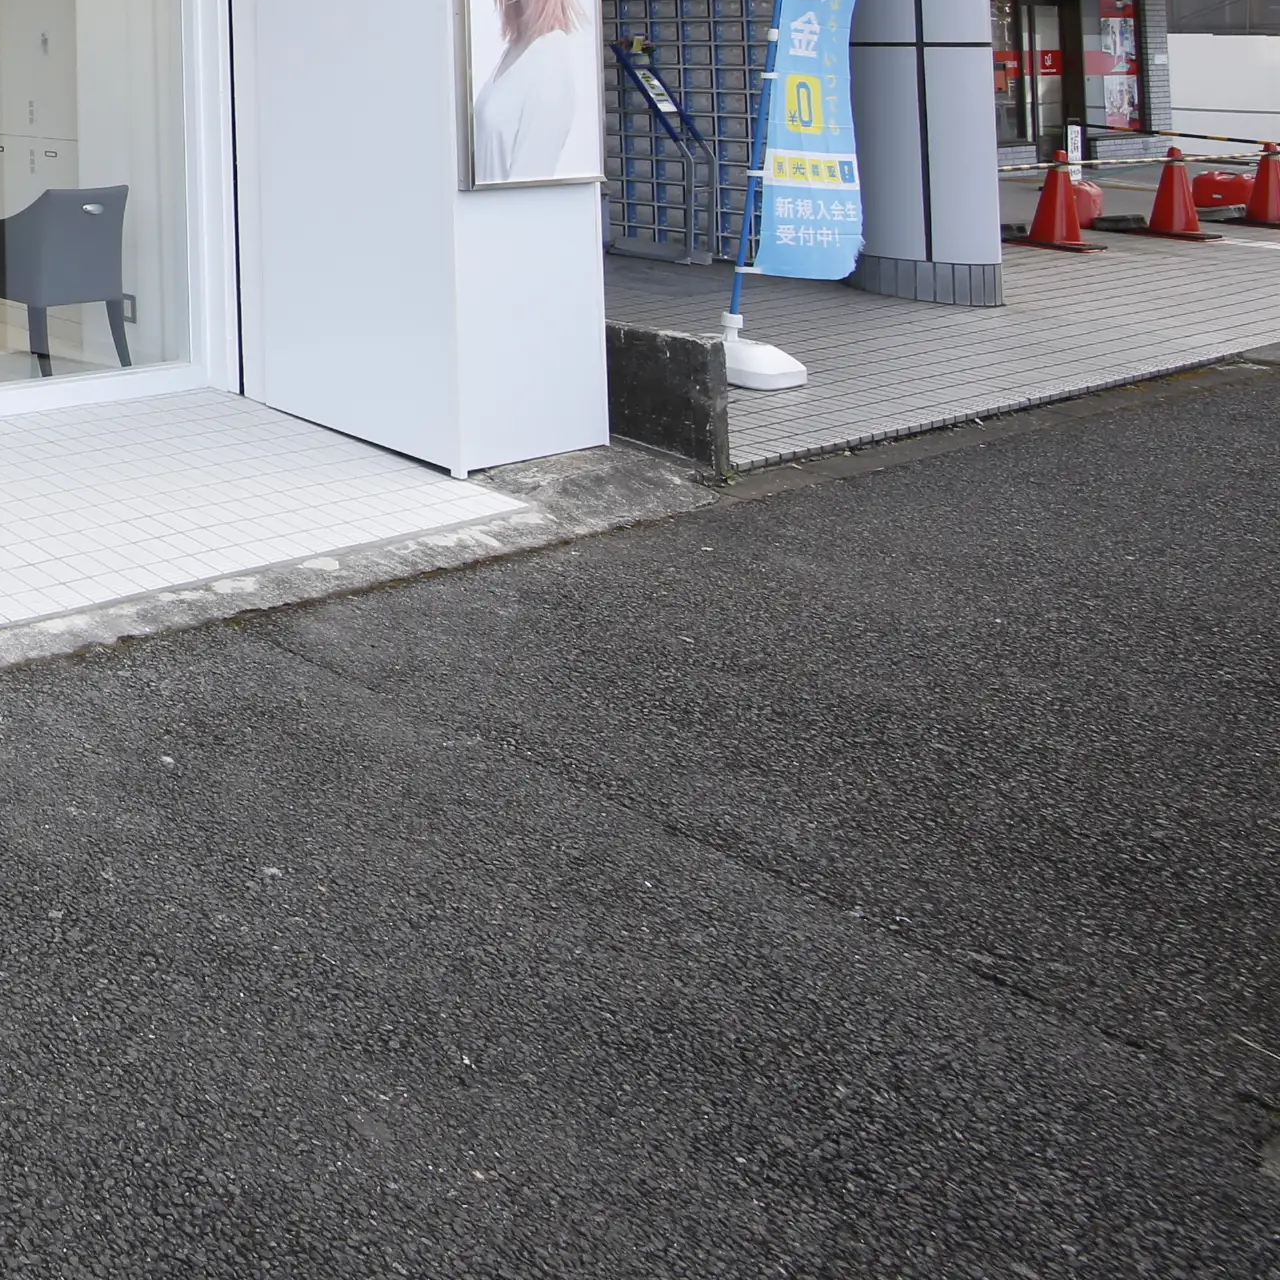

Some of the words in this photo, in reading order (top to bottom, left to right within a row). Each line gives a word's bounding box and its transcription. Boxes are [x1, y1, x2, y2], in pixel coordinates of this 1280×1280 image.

[796, 81, 813, 127] 0
[775, 197, 858, 223] 新規入会生
[775, 224, 841, 248] 受付中!
